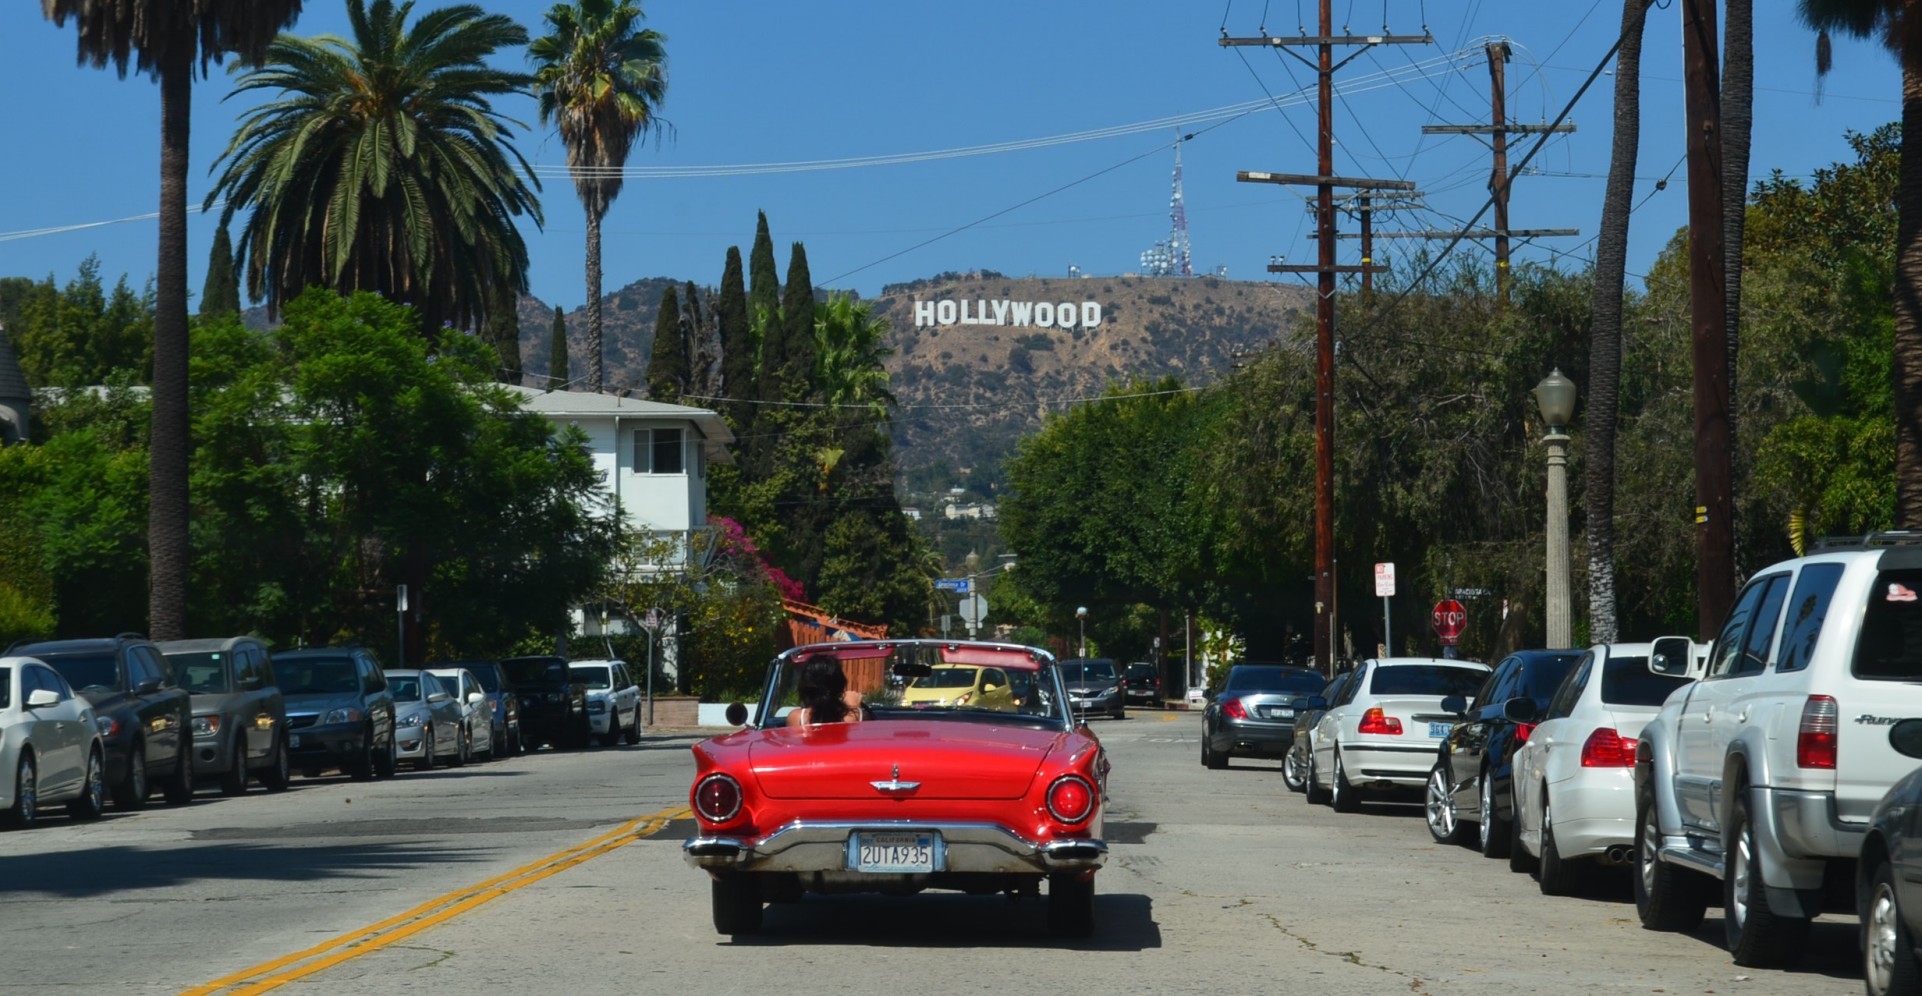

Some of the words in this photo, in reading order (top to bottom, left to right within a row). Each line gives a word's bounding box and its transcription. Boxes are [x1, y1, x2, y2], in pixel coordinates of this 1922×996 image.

[915, 299, 1101, 328] HOLLYWOOD
[1434, 611, 1464, 626] STOP
[863, 846, 928, 864] 2UTA935
